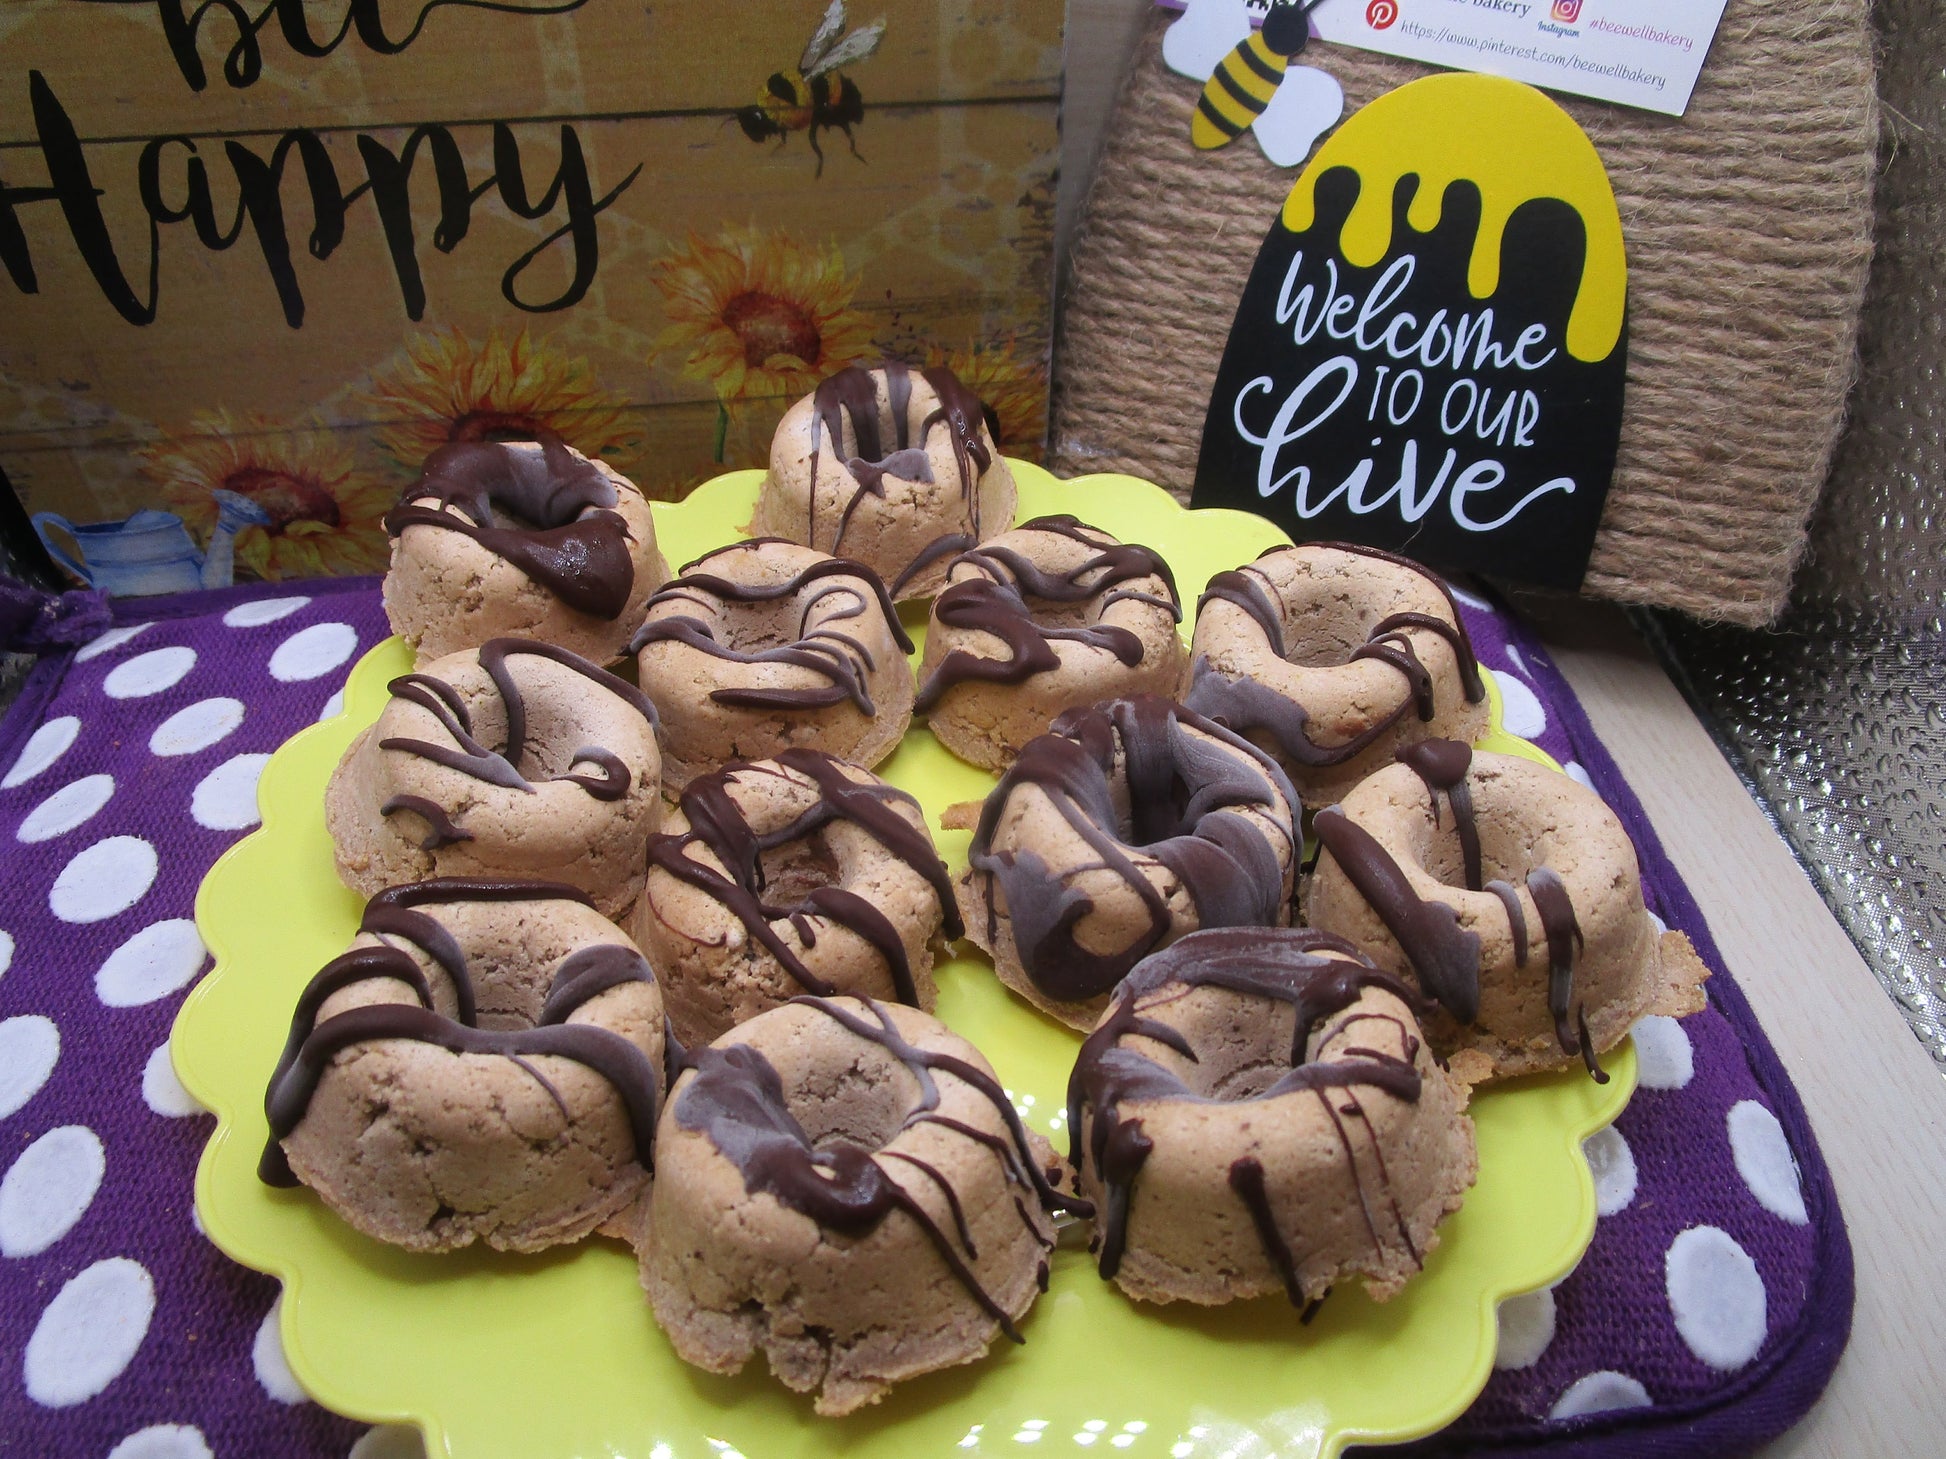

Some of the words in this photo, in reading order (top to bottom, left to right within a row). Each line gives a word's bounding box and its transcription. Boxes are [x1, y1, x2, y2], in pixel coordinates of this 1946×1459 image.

[1472, 0, 1532, 18] bakery
[1537, 21, 1580, 38] Instagram
[1589, 17, 1694, 51] #beewellbakery
[1400, 20, 1667, 91] https://www.pinterest.com/beewellbakery
[0, 69, 643, 329] Happy
[1275, 250, 1557, 370] Welcome
[1367, 365, 1424, 426] TO
[1233, 355, 1576, 532] hive
